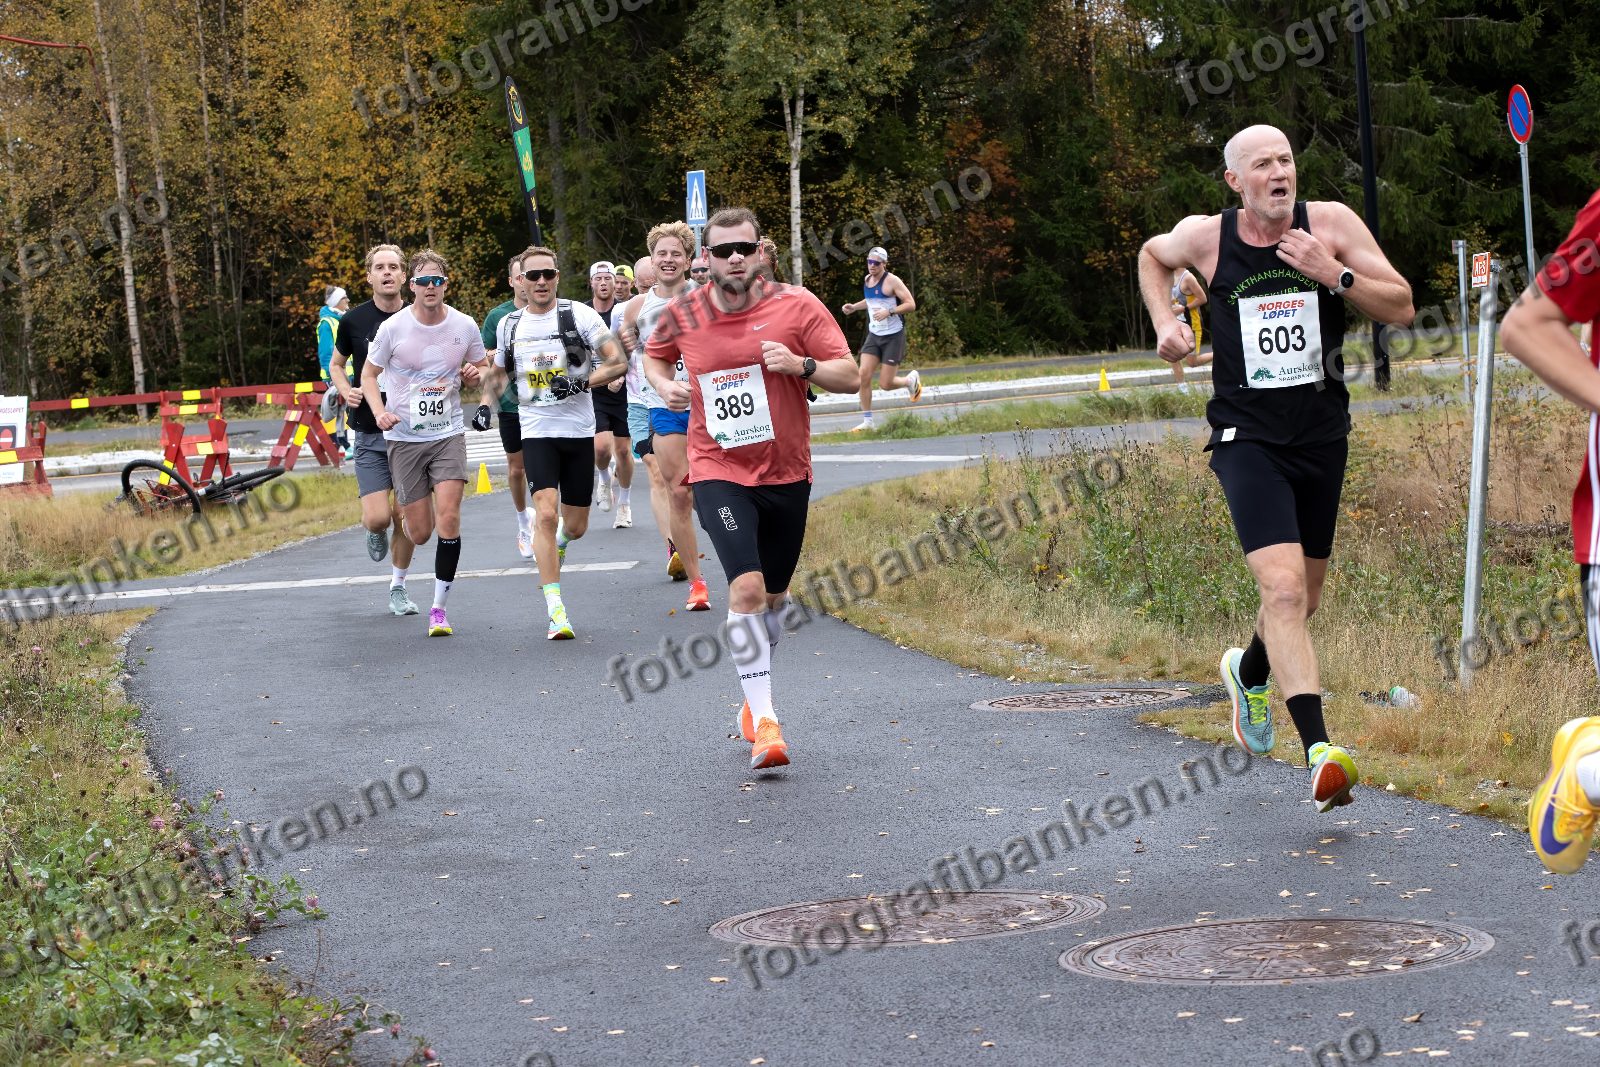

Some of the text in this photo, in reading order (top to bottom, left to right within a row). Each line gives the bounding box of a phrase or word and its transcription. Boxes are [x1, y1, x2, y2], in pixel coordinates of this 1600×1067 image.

[1256, 299, 1305, 312] NORGES
[1262, 308, 1298, 320] LØPET
[1258, 324, 1307, 355] 603
[1278, 362, 1320, 376] Aurskog
[712, 371, 751, 385] NORGES
[716, 379, 745, 392] LØPET
[418, 399, 444, 417] 949
[714, 392, 755, 421] 389
[733, 424, 771, 438] Aurskog
[718, 506, 738, 531] 2XU
